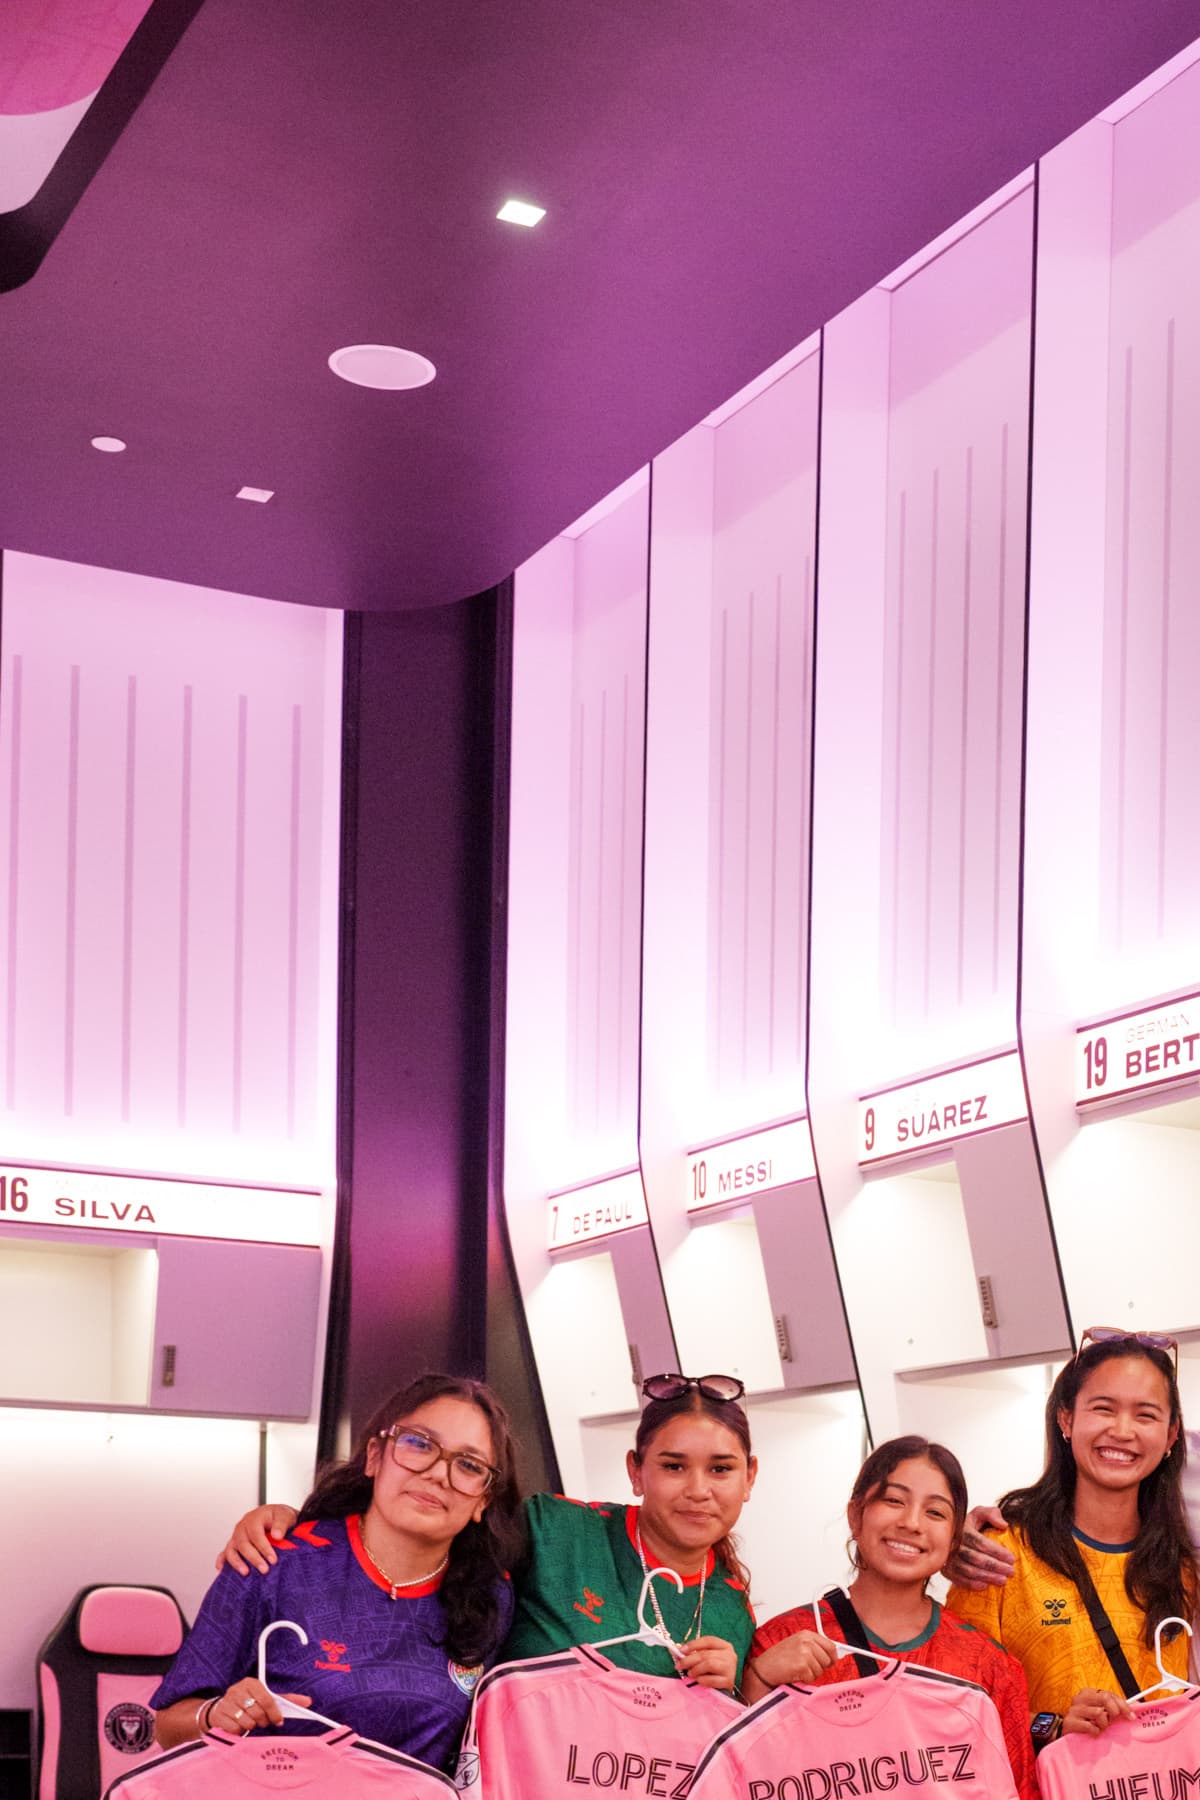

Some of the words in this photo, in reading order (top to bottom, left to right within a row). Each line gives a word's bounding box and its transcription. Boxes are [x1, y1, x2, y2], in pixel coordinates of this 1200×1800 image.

[1083, 1037, 1107, 1089] 19
[865, 1107, 875, 1151] 9
[897, 1095, 987, 1142] SUÁREZ
[0, 1176, 28, 1212] 16
[55, 1197, 155, 1223] SILVA
[692, 1160, 707, 1201] 10
[719, 1159, 772, 1193] MESSI
[573, 1212, 590, 1235] DE
[596, 1200, 632, 1229] PAUL
[1041, 1617, 1072, 1626] hummel
[566, 1744, 696, 1800] LOPEZ
